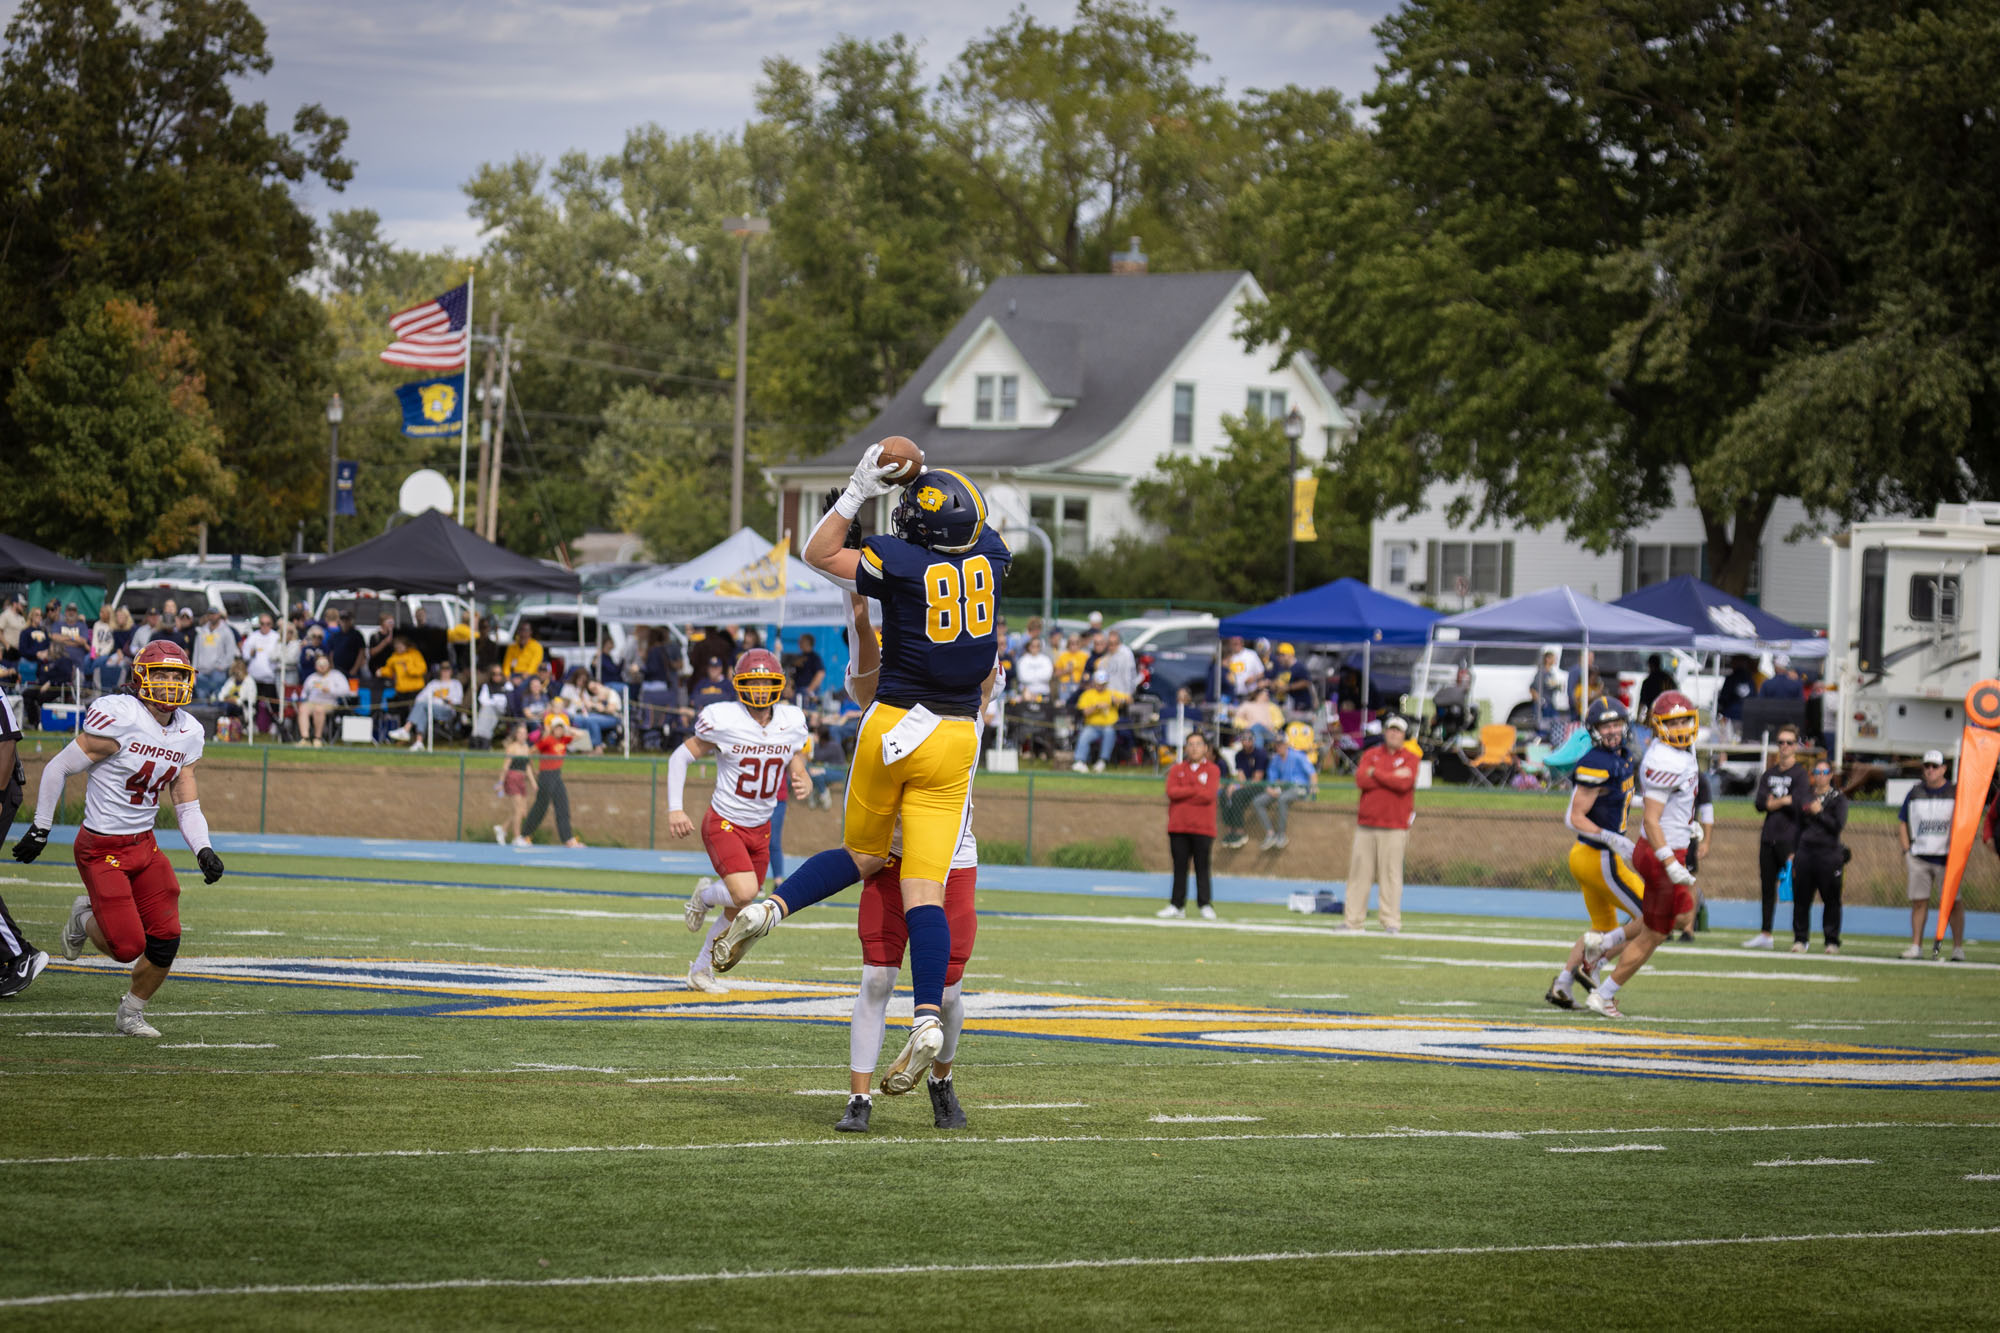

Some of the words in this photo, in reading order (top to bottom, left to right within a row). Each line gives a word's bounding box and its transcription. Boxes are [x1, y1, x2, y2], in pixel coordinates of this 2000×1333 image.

[923, 554, 995, 644] 88
[128, 741, 187, 764] SIMPSON
[731, 744, 792, 755] SIMPSON
[125, 760, 178, 807] 44
[735, 757, 784, 800] 20
